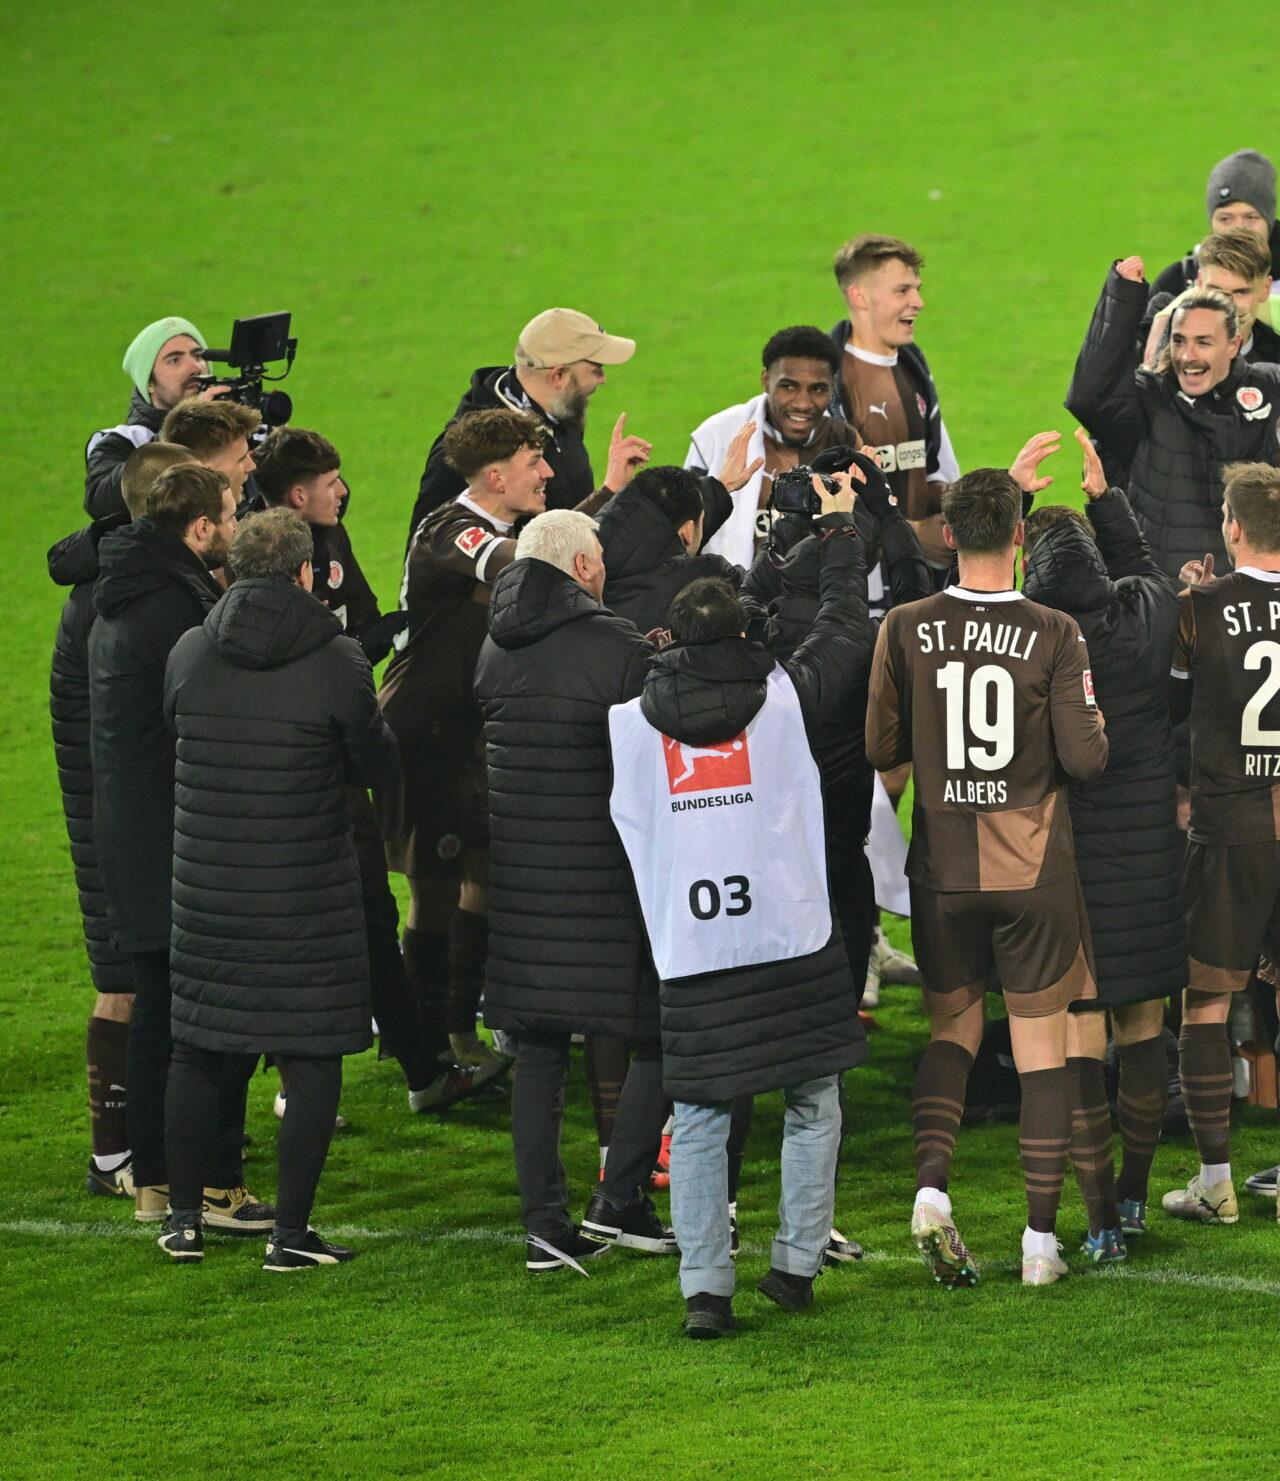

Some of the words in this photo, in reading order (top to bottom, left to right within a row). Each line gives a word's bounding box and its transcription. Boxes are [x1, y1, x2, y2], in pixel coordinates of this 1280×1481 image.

[1223, 601, 1262, 636] ST.
[917, 620, 956, 653] ST.
[963, 620, 1038, 660] PAULI
[936, 661, 1015, 771] 19
[671, 792, 754, 813] BUNDESLIGA
[943, 780, 1007, 804] ALBERS
[688, 874, 752, 920] 03
